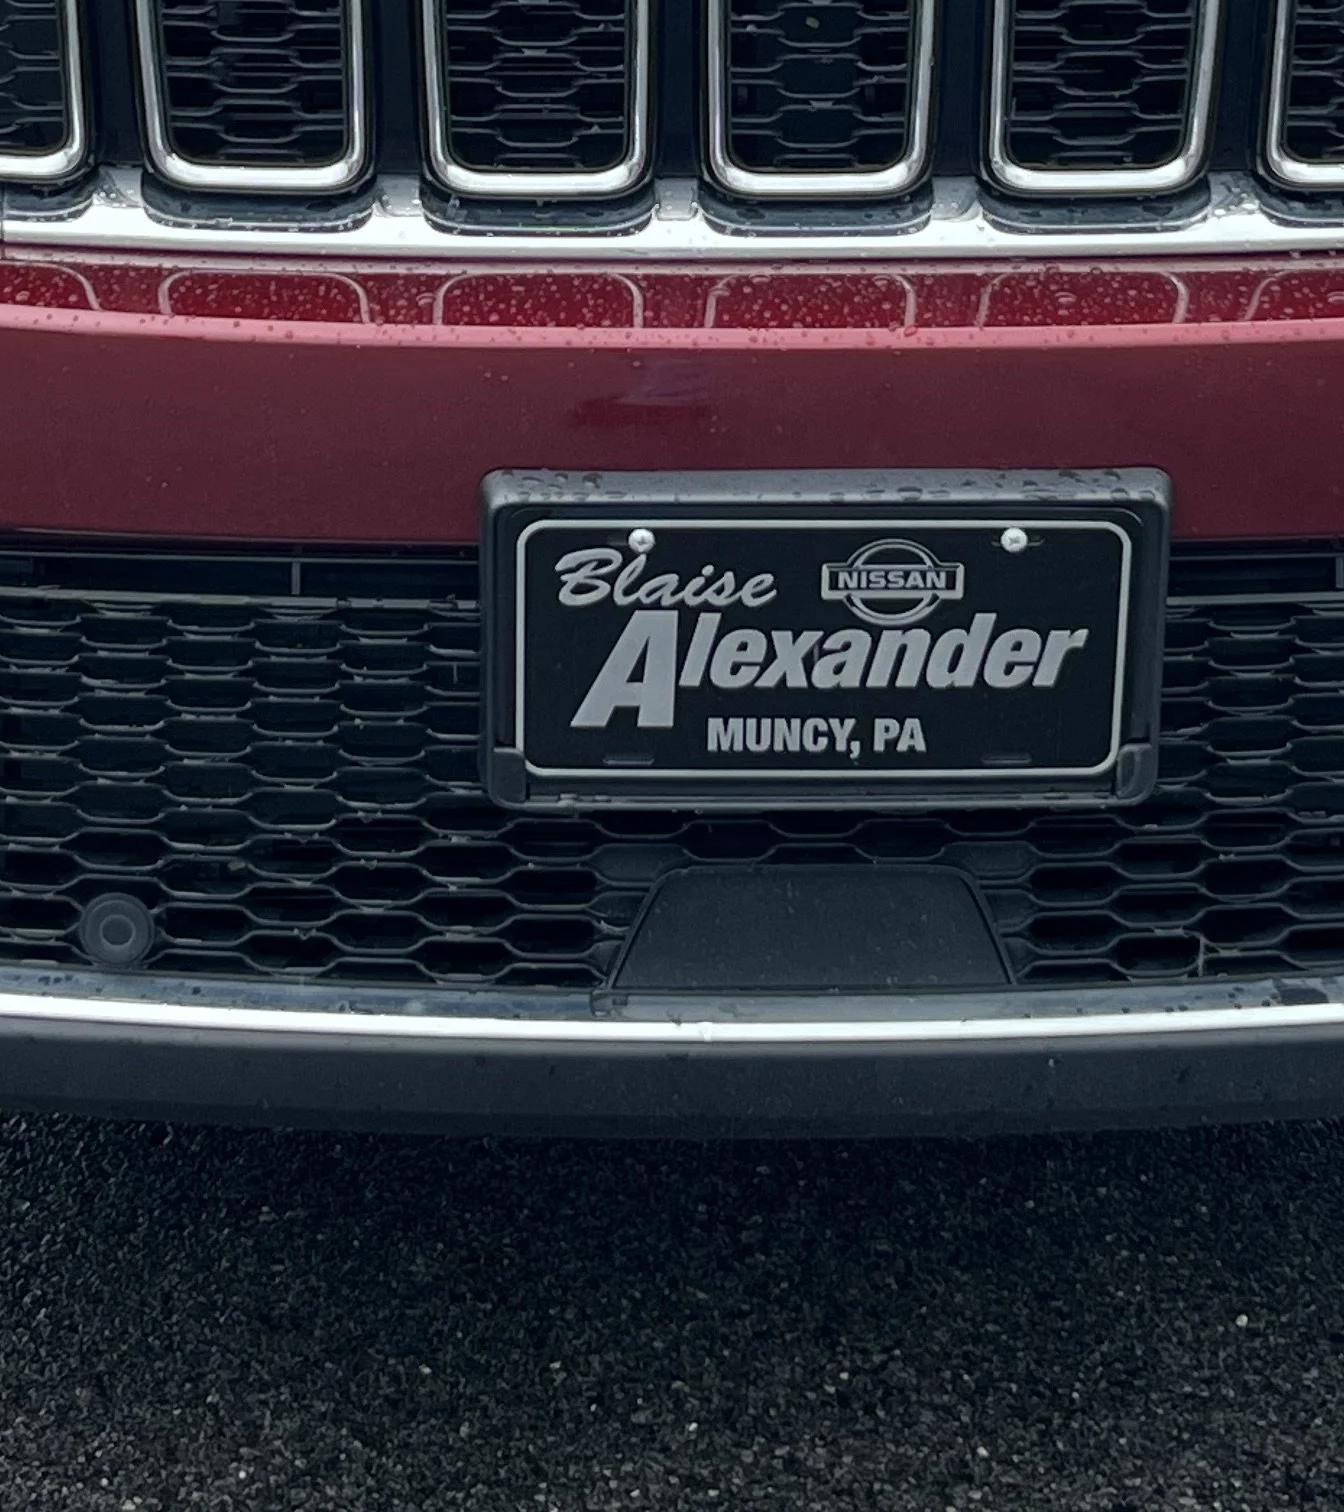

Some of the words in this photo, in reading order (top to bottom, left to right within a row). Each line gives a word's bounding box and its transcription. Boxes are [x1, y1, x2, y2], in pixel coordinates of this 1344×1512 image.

[554, 548, 777, 607] Blaise
[837, 570, 947, 589] NISSAN
[570, 609, 1090, 728] Alexander
[706, 717, 861, 756] MUNCY,
[872, 717, 927, 752] PA
